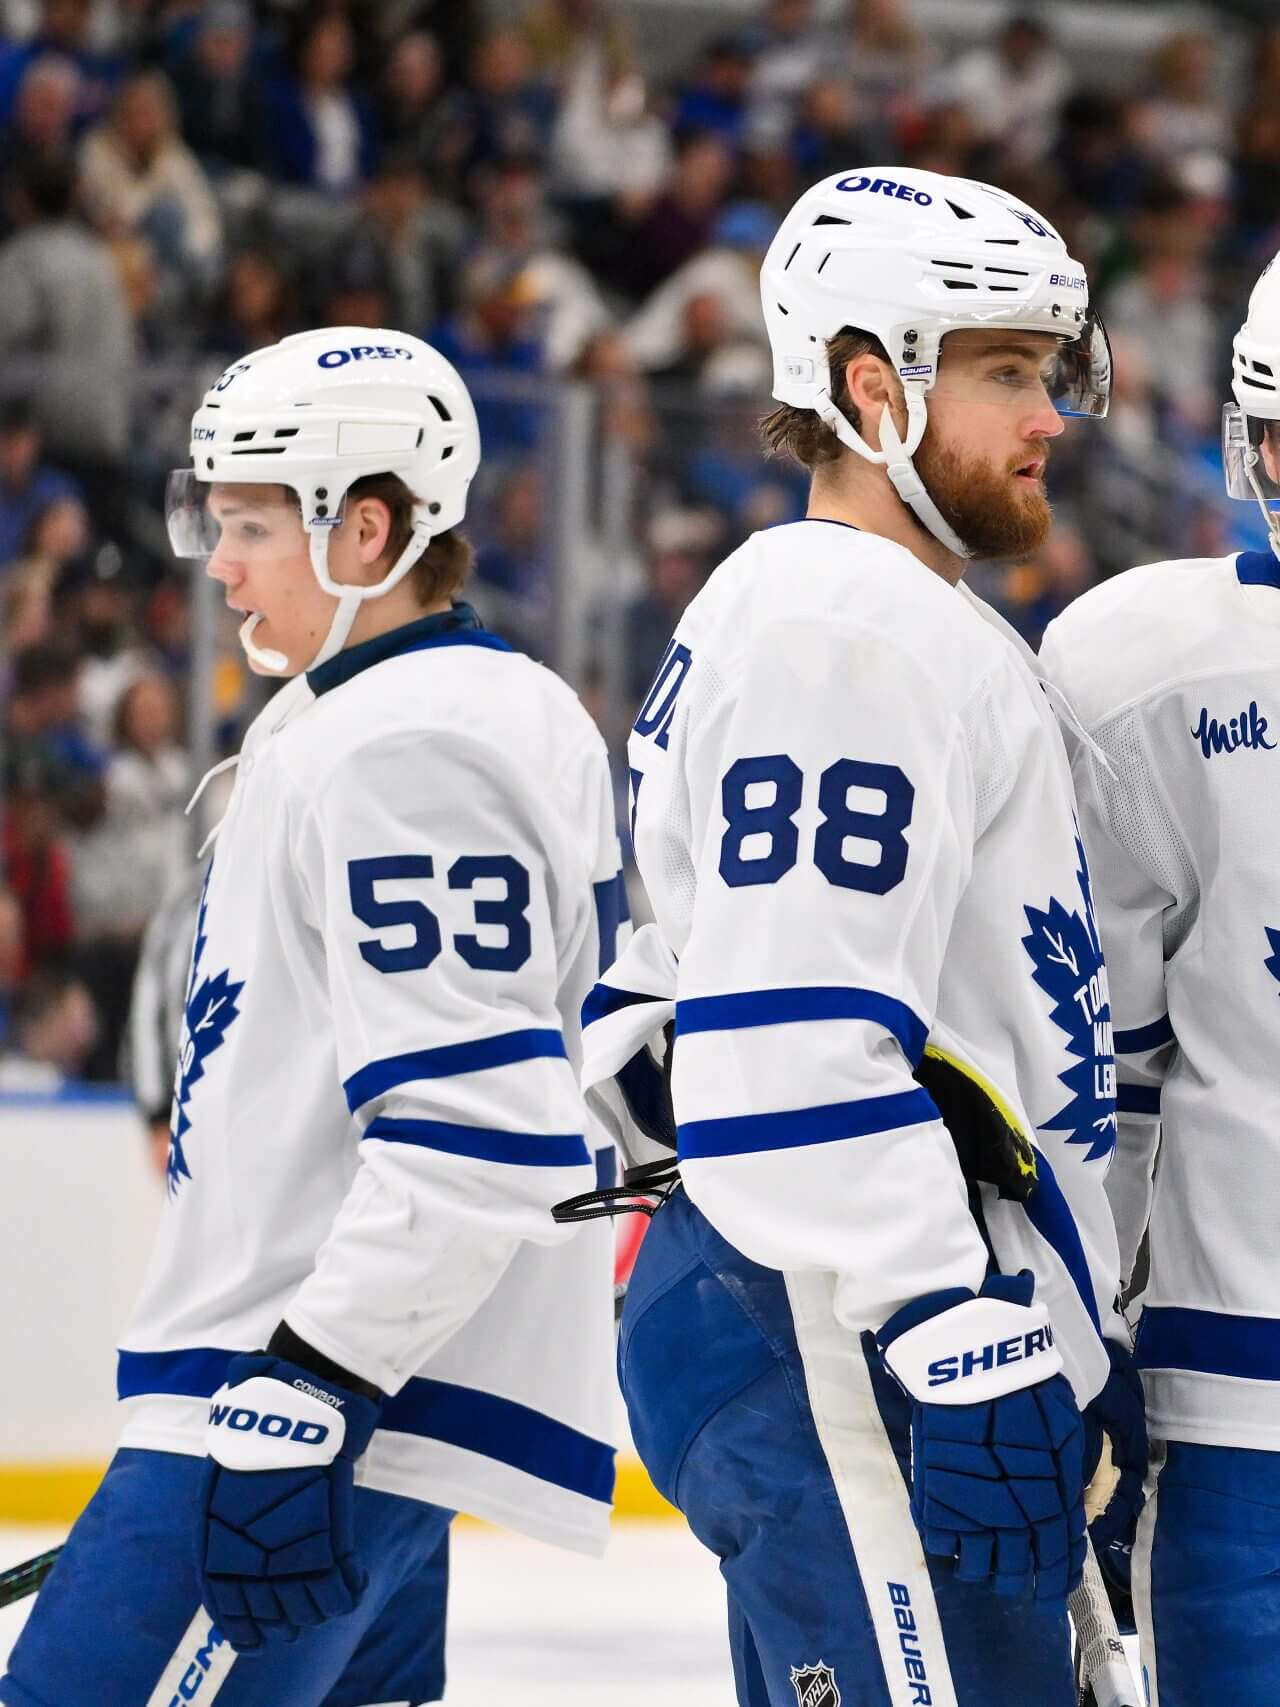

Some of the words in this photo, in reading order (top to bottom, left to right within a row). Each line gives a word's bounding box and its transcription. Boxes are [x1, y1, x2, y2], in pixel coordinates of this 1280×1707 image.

[835, 175, 933, 207] OREO
[317, 346, 413, 369] OREO
[718, 754, 915, 896] 88
[347, 854, 532, 974] 53
[292, 1379, 345, 1408] COWBOY
[169, 1623, 225, 1707] CM
